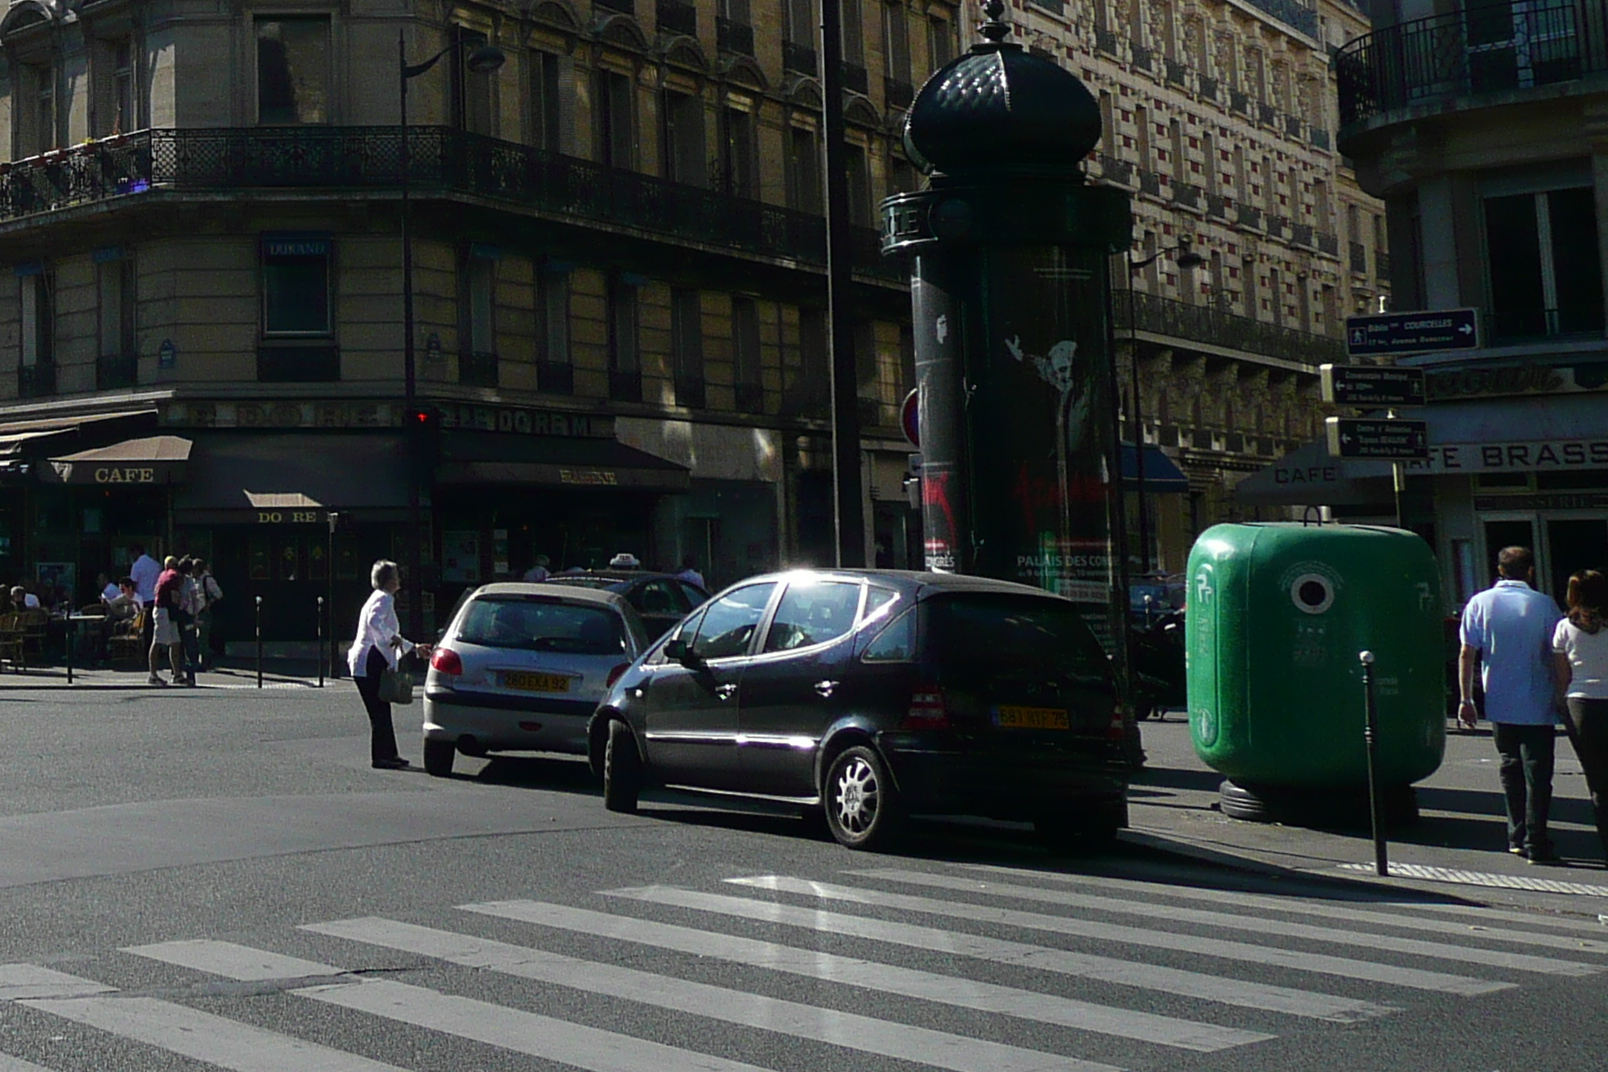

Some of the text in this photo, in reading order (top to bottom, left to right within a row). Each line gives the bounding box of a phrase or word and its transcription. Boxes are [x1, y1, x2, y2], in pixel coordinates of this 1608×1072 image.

[1403, 318, 1454, 331] COURCELLES
[1482, 441, 1608, 467] BRASS
[94, 467, 154, 483] CAFE
[1275, 466, 1337, 485] CAFE
[257, 510, 317, 524] DO RE
[1016, 554, 1062, 567] PALAIS
[1064, 554, 1087, 567] DES
[551, 676, 567, 691] 92
[1052, 710, 1067, 726] 75
